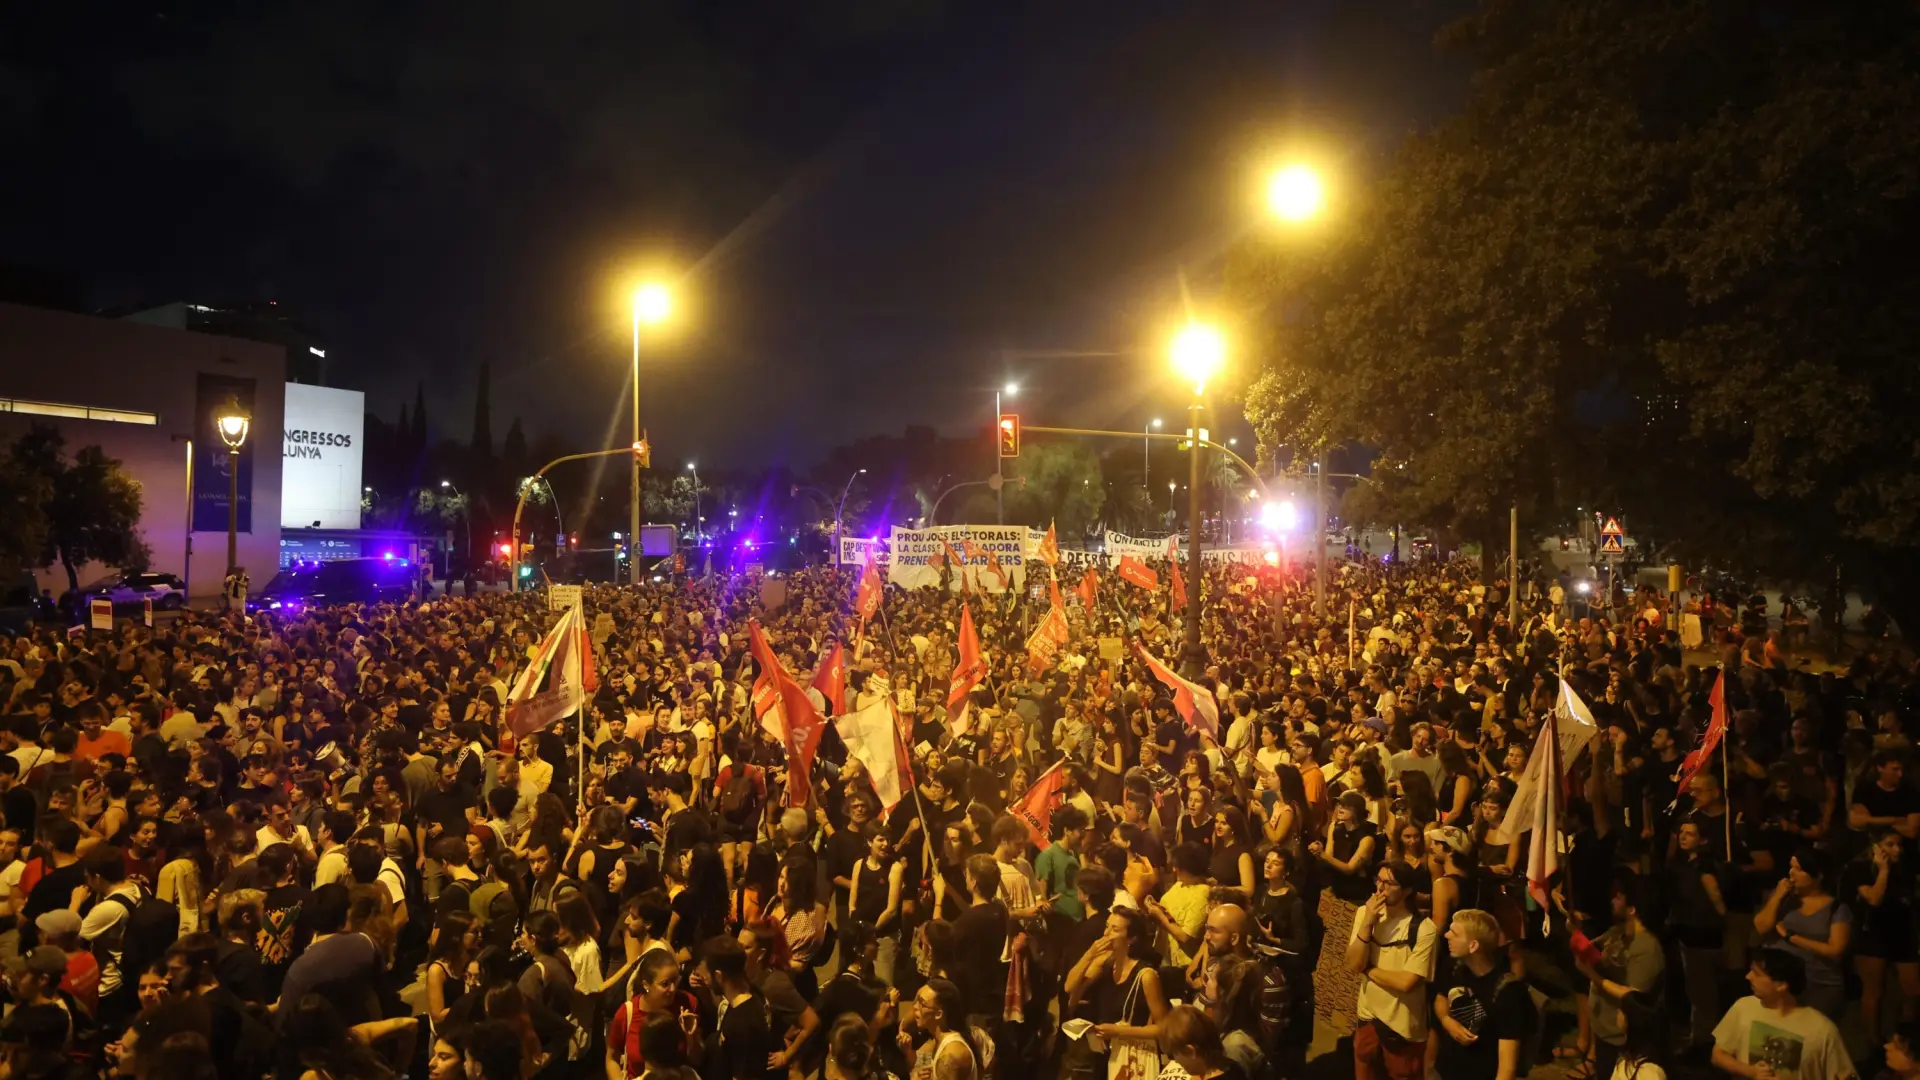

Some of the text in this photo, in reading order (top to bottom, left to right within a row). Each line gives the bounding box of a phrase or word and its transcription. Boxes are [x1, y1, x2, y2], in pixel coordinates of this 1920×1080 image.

[284, 429, 351, 447] NGRESSOS
[897, 533, 924, 542] PROU
[951, 531, 1020, 541] ELECTORALS:
[843, 541, 854, 552] CAP
[898, 544, 909, 553] LA
[897, 556, 928, 565] PRENE
[962, 554, 1021, 565] CARERS
